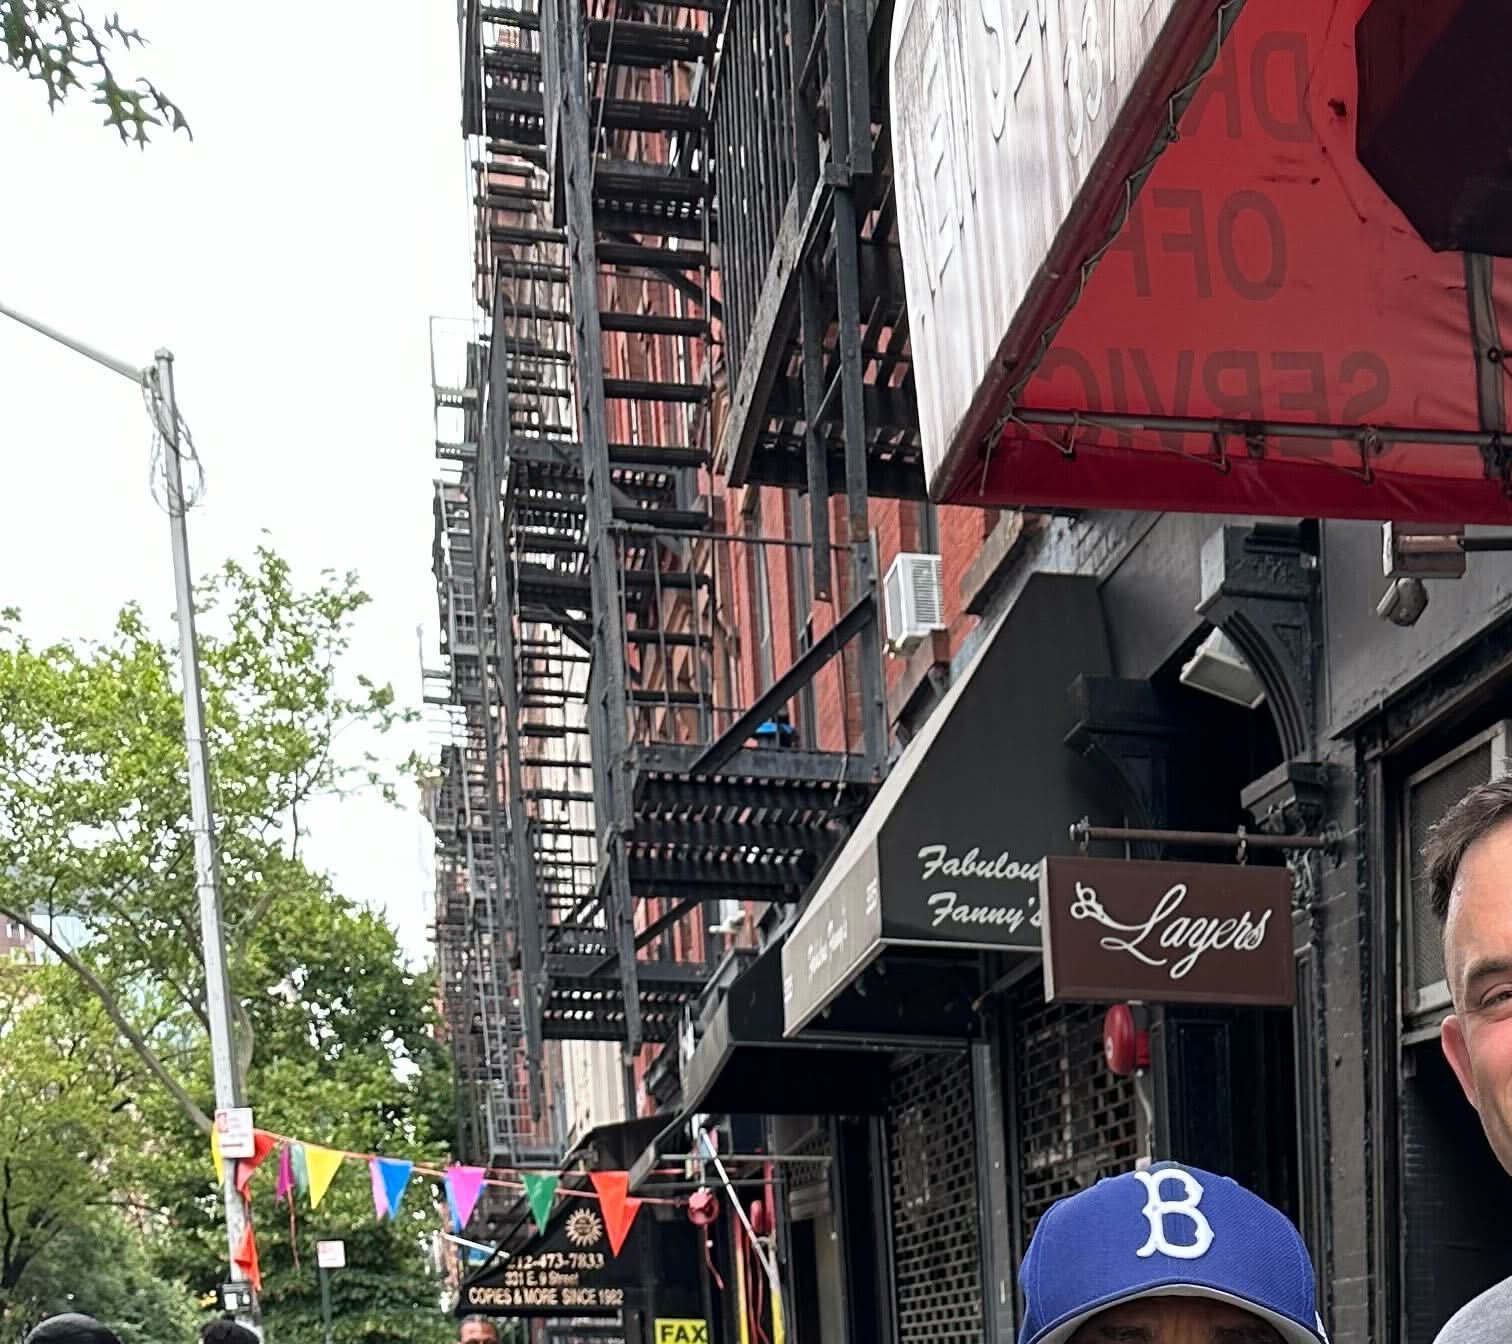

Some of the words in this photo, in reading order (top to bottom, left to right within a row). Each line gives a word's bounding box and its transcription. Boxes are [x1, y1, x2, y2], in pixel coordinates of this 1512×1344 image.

[918, 844, 1041, 881] Fabulou
[927, 891, 1042, 933] Fanny's
[1099, 883, 1273, 979] Layers
[1134, 1168, 1215, 1260] B
[469, 1288, 512, 1305] COPIES
[524, 1288, 558, 1305] MORE
[562, 1288, 597, 1305] SINCE
[661, 1325, 708, 1343] FAX
